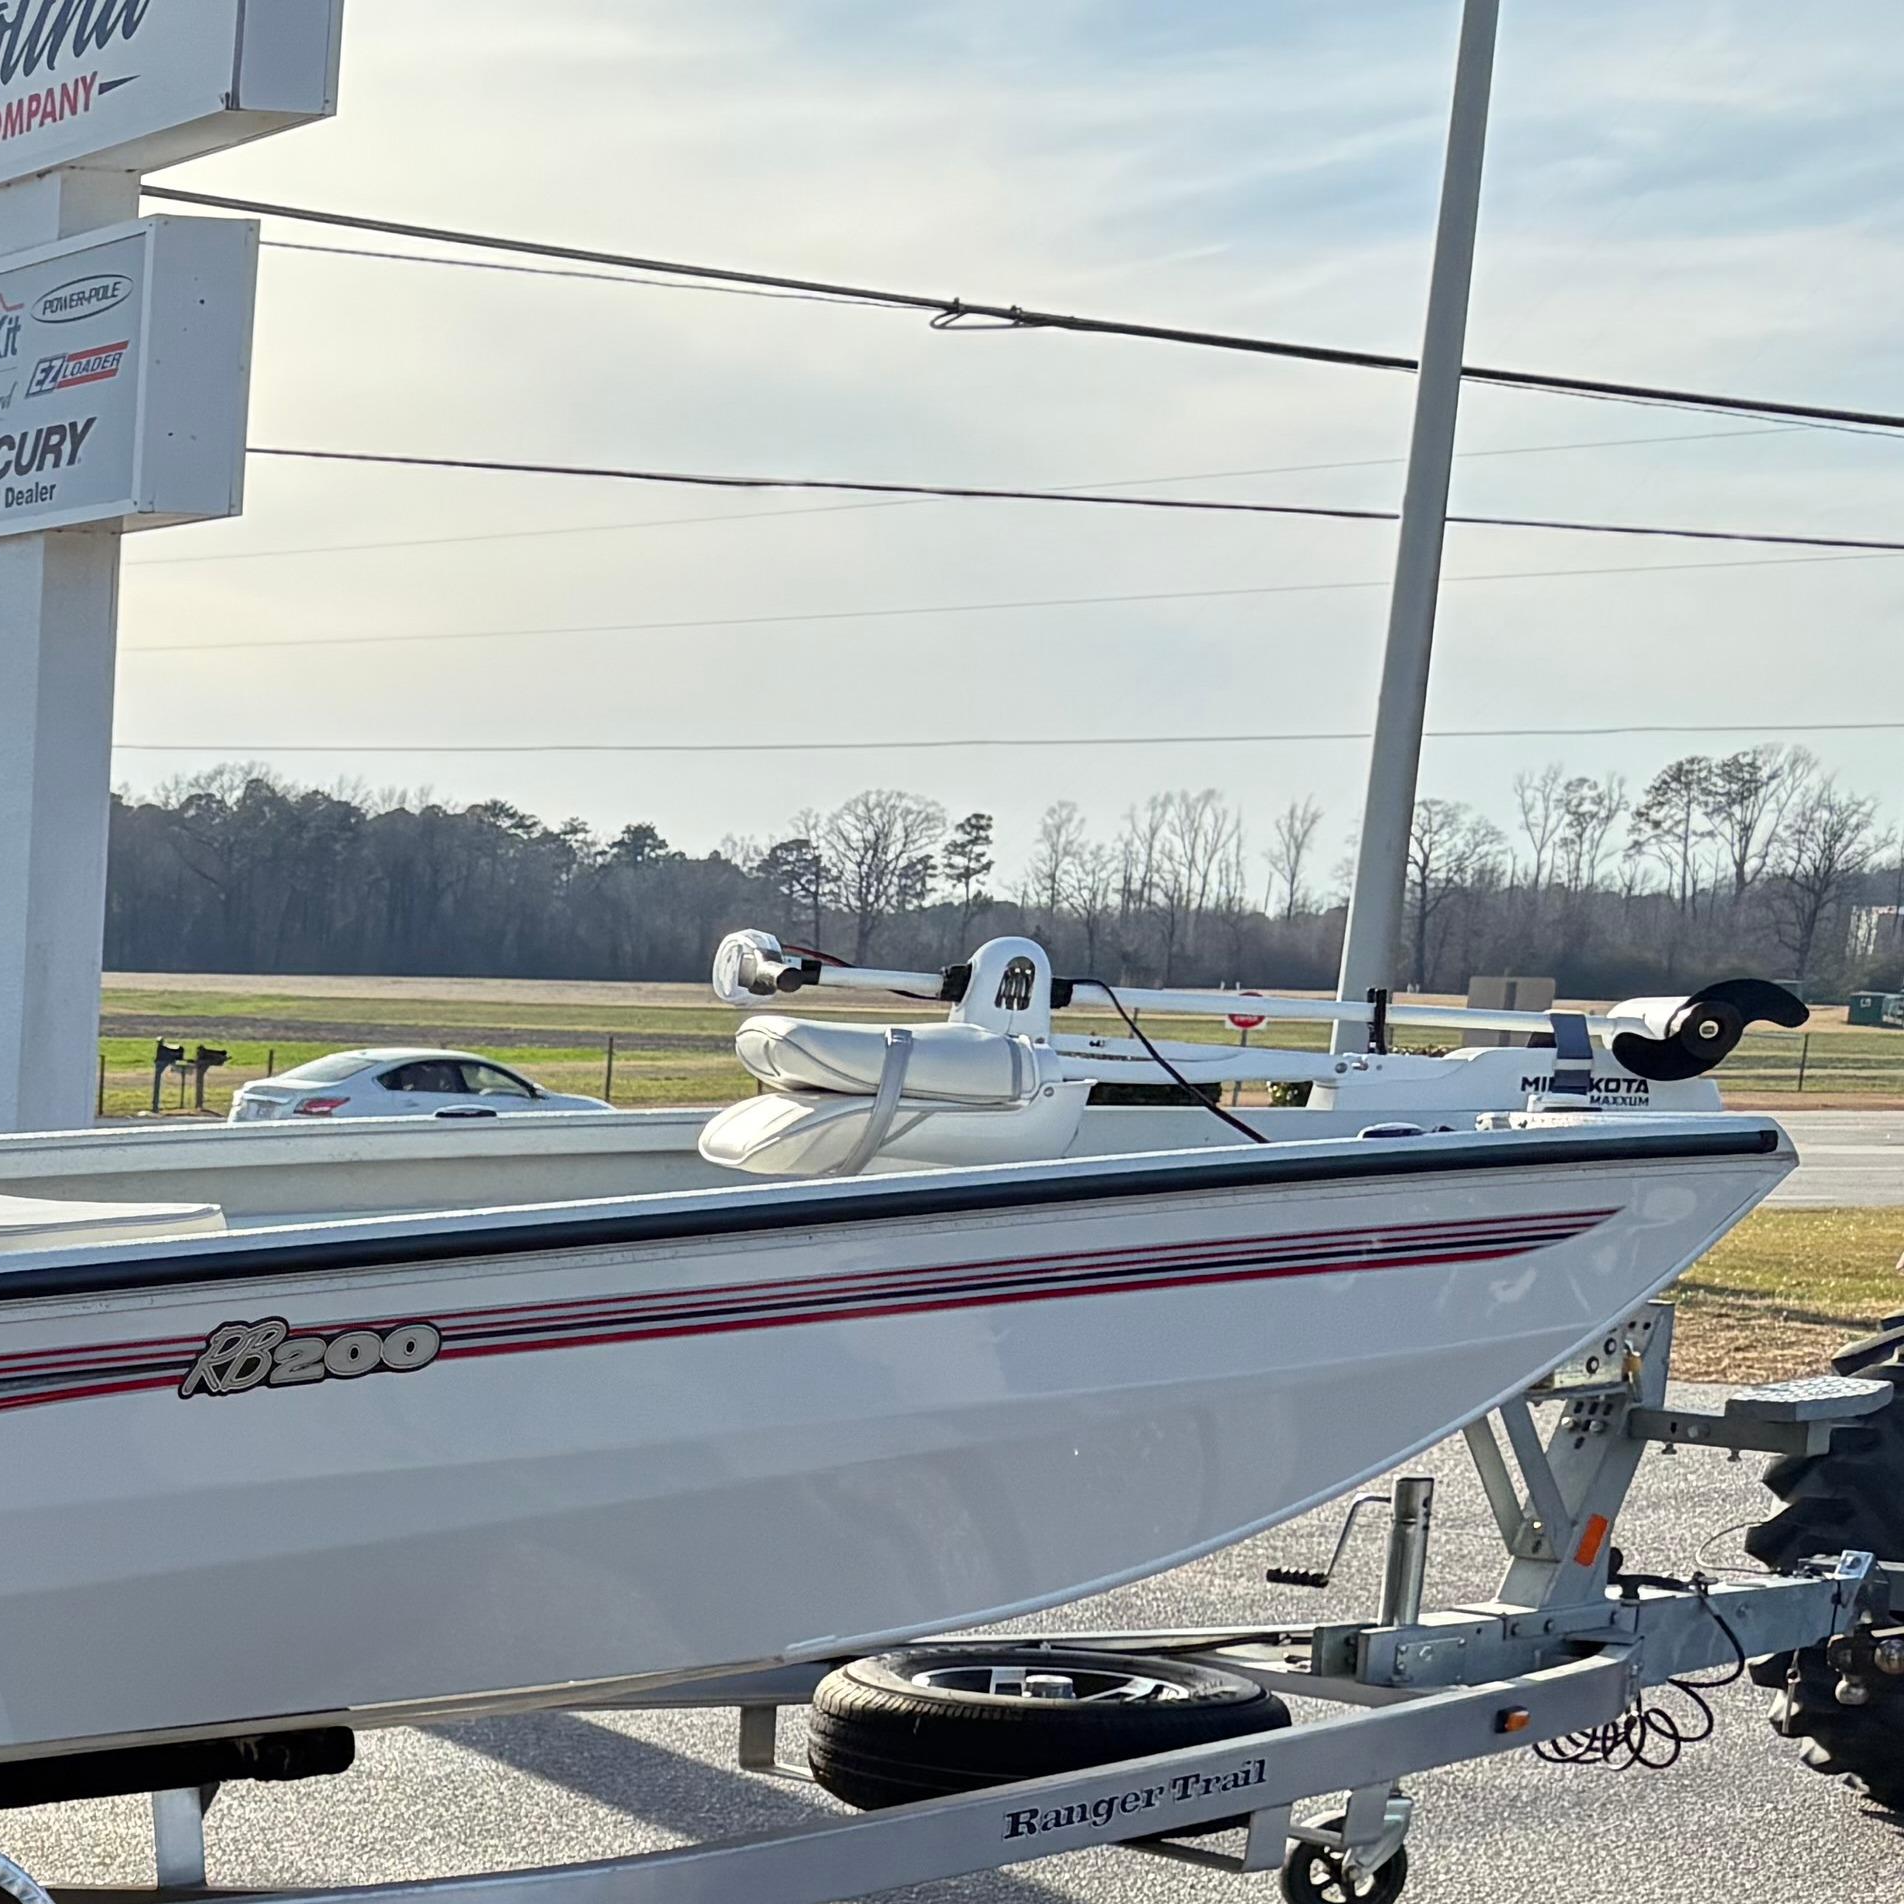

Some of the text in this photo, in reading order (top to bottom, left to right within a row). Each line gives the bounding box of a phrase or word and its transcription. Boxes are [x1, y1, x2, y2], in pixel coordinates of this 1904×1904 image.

[42, 281, 122, 315] POWER-POLE
[61, 352, 124, 379] LOADER
[5, 482, 55, 508] Dealer
[1589, 1077, 1649, 1094] KOTA
[1590, 1095, 1649, 1107] MAXXUM
[178, 1316, 441, 1399] RB200
[1003, 1758, 1267, 1839] Ranger Trail
